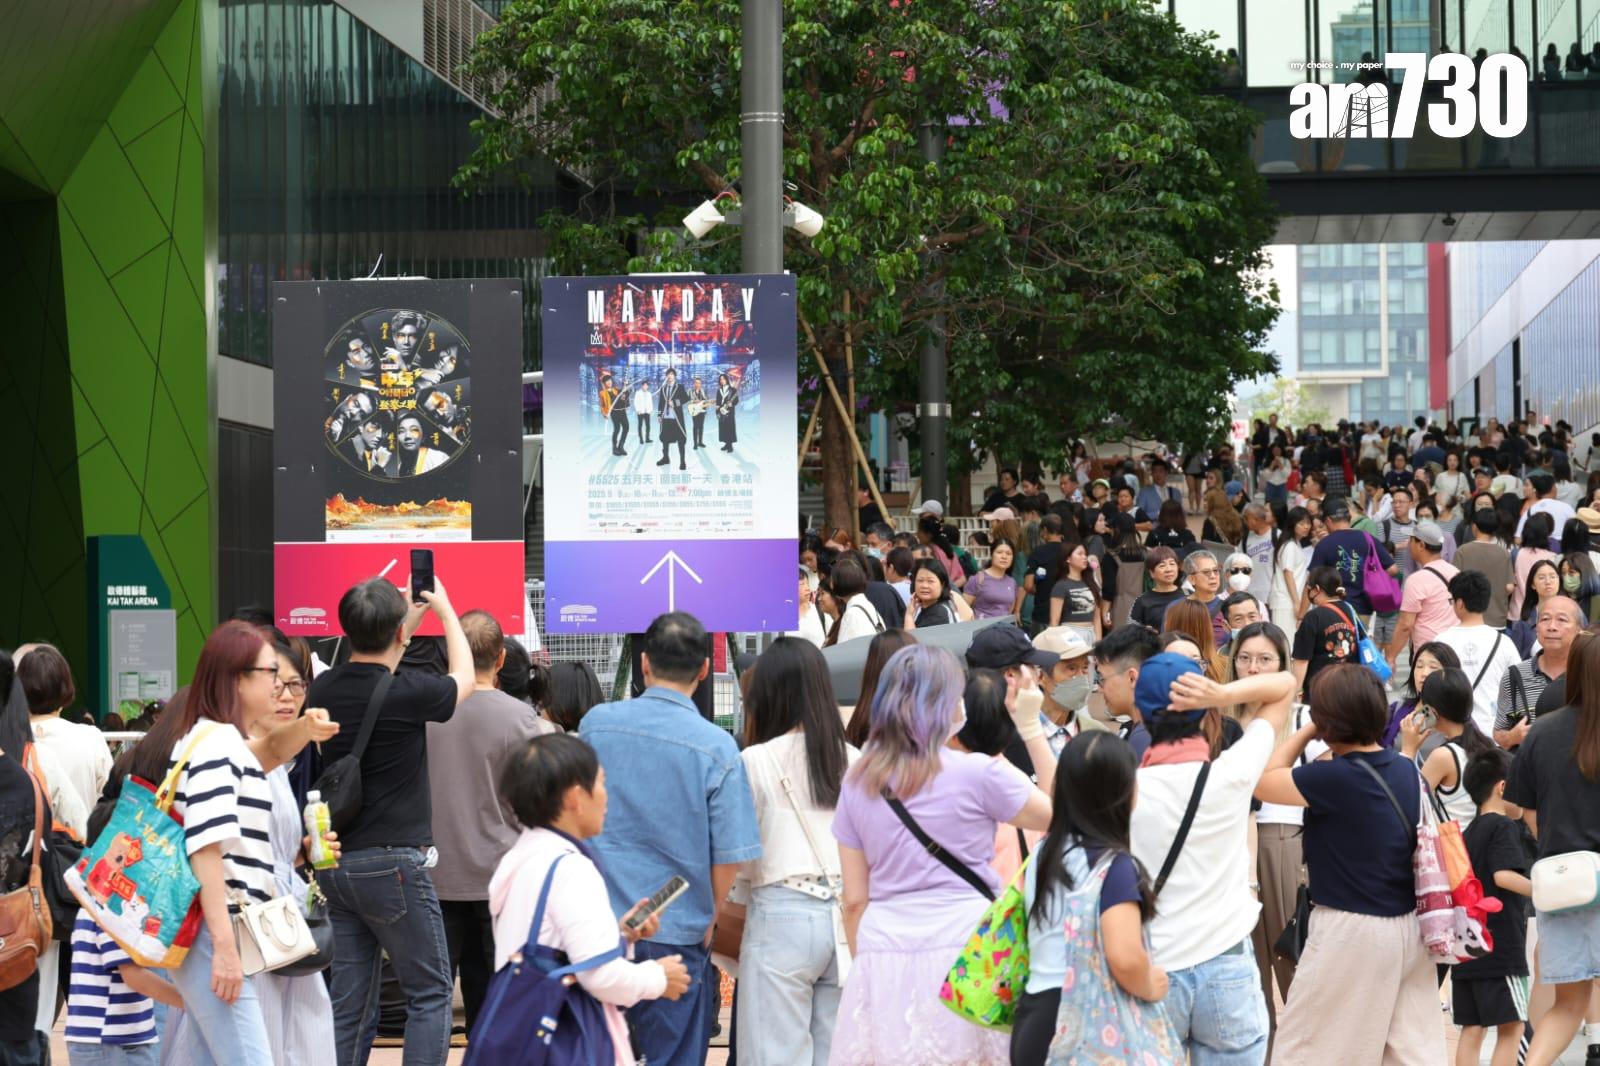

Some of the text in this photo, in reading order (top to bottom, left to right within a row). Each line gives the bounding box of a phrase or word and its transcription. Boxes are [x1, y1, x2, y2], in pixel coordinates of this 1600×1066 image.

[107, 597, 159, 606] KAI TAK ARENA
